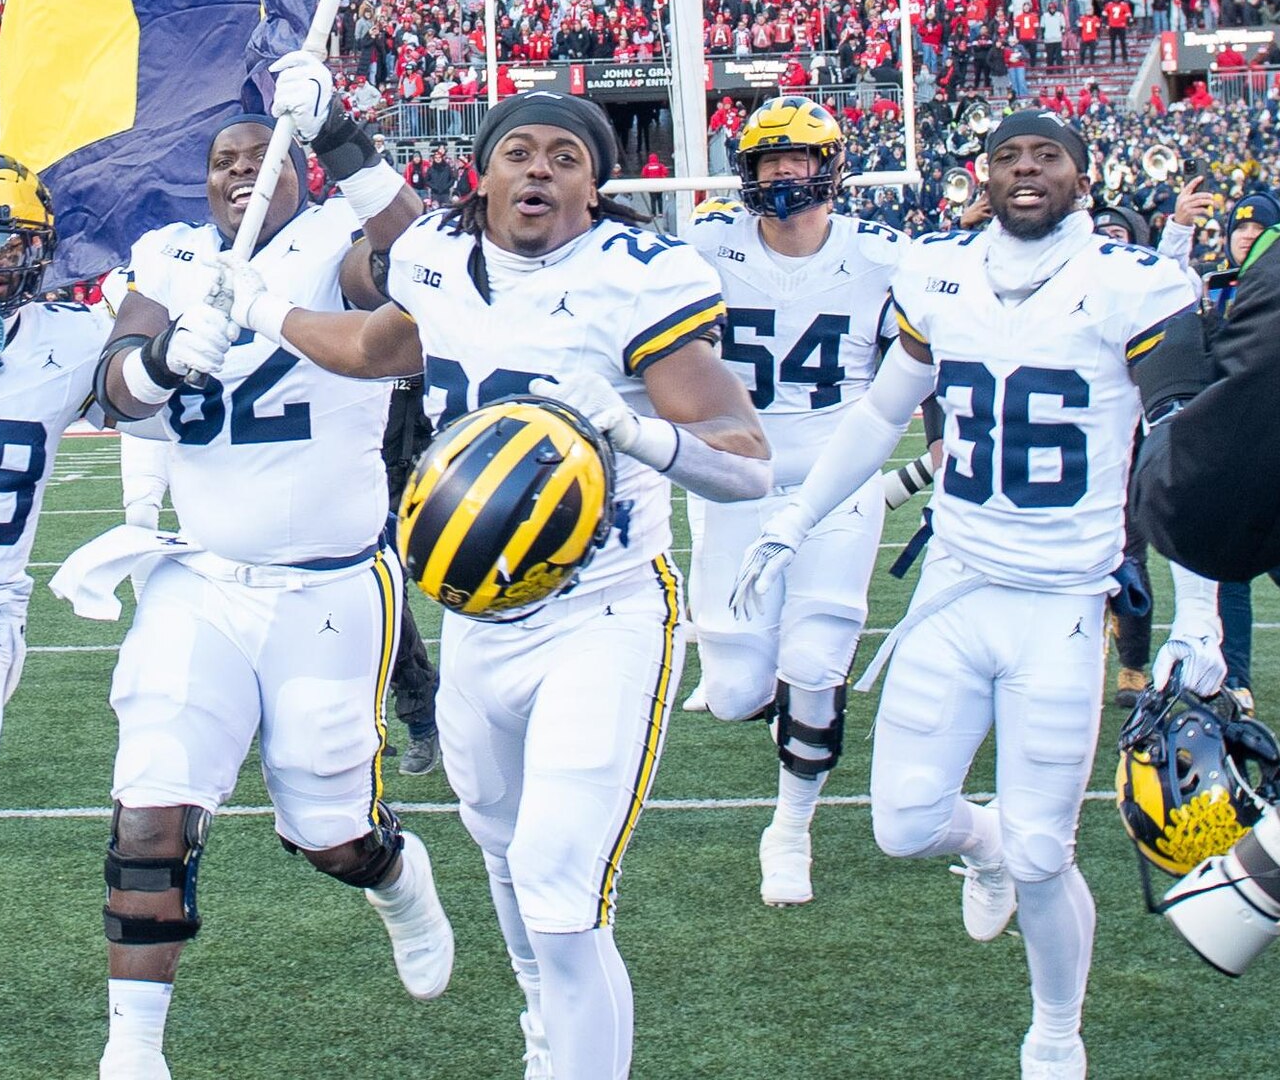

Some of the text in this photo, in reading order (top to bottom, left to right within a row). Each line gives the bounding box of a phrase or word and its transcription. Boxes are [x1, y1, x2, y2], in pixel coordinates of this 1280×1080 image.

[587, 80, 615, 89] BAND
[602, 69, 633, 79] JOHN
[634, 69, 646, 78] C.
[721, 307, 851, 410] 54
[936, 359, 1090, 508] 36
